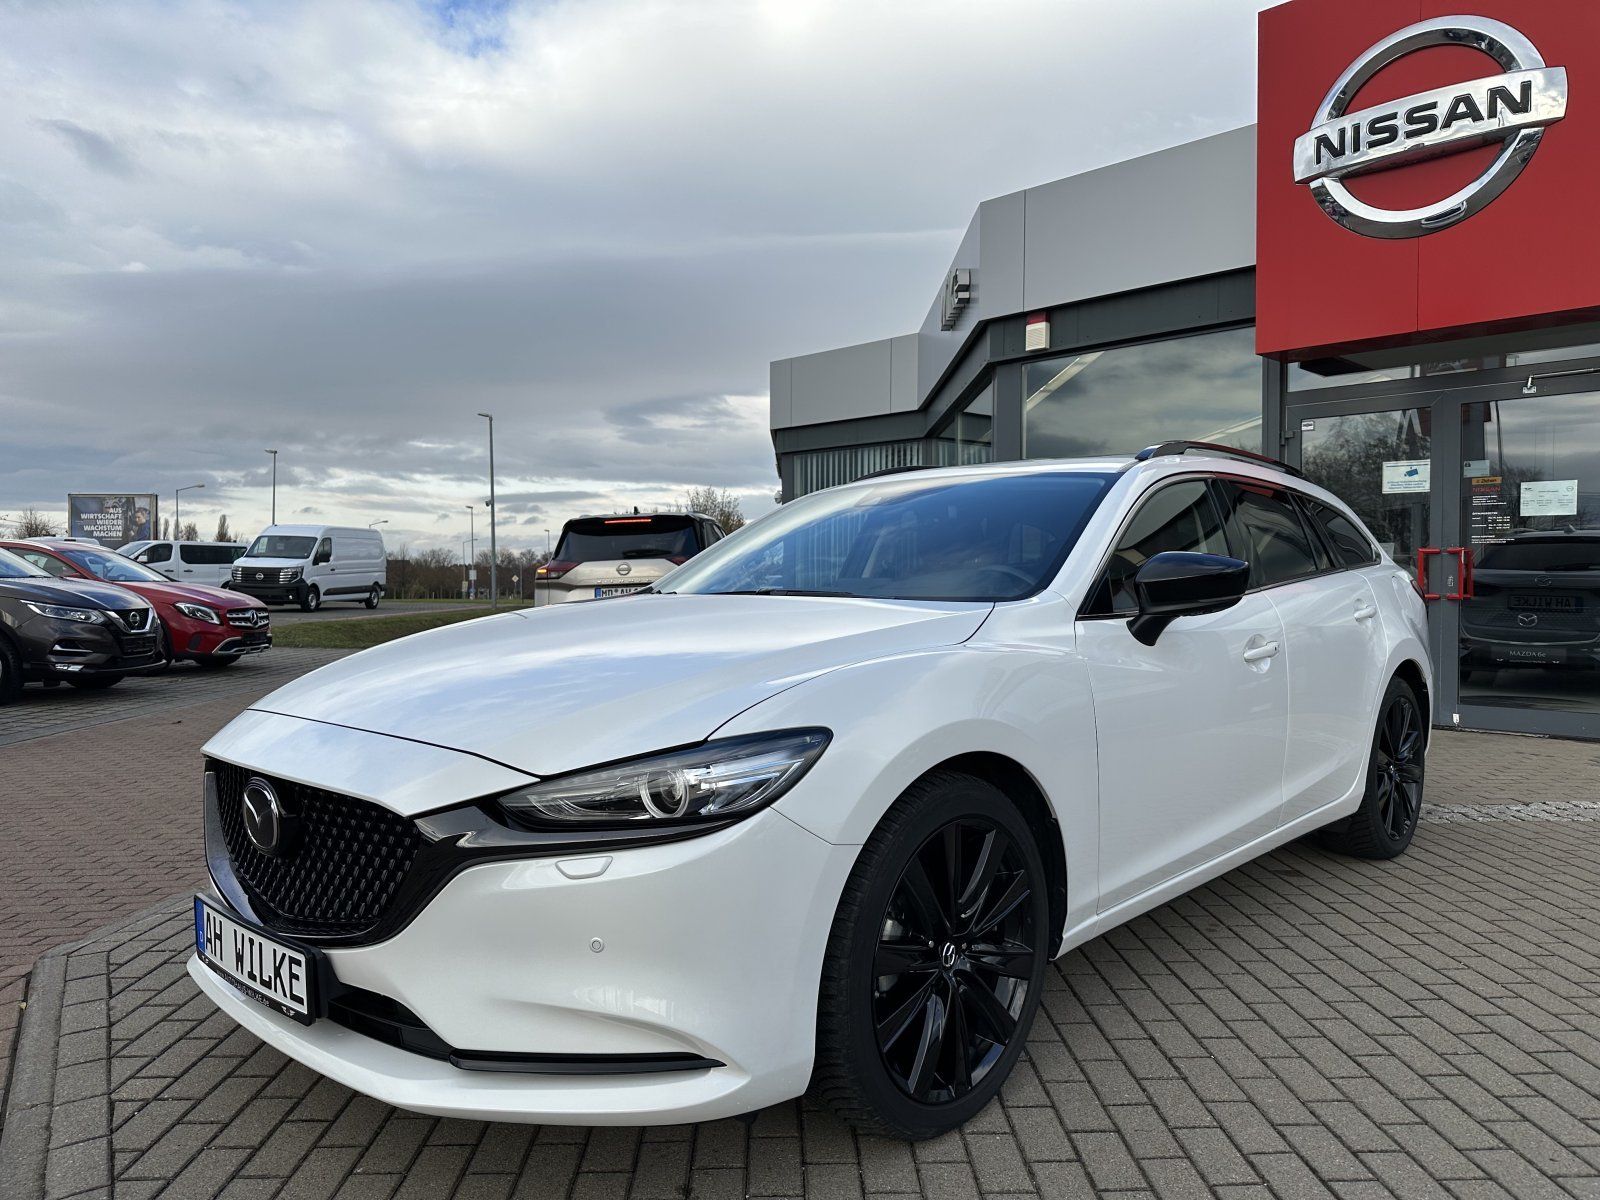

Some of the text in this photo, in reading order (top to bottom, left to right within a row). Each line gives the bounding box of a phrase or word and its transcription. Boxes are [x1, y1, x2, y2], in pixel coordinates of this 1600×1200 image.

[1314, 80, 1532, 165] NISSAN
[205, 911, 305, 1007] AH WILKE
